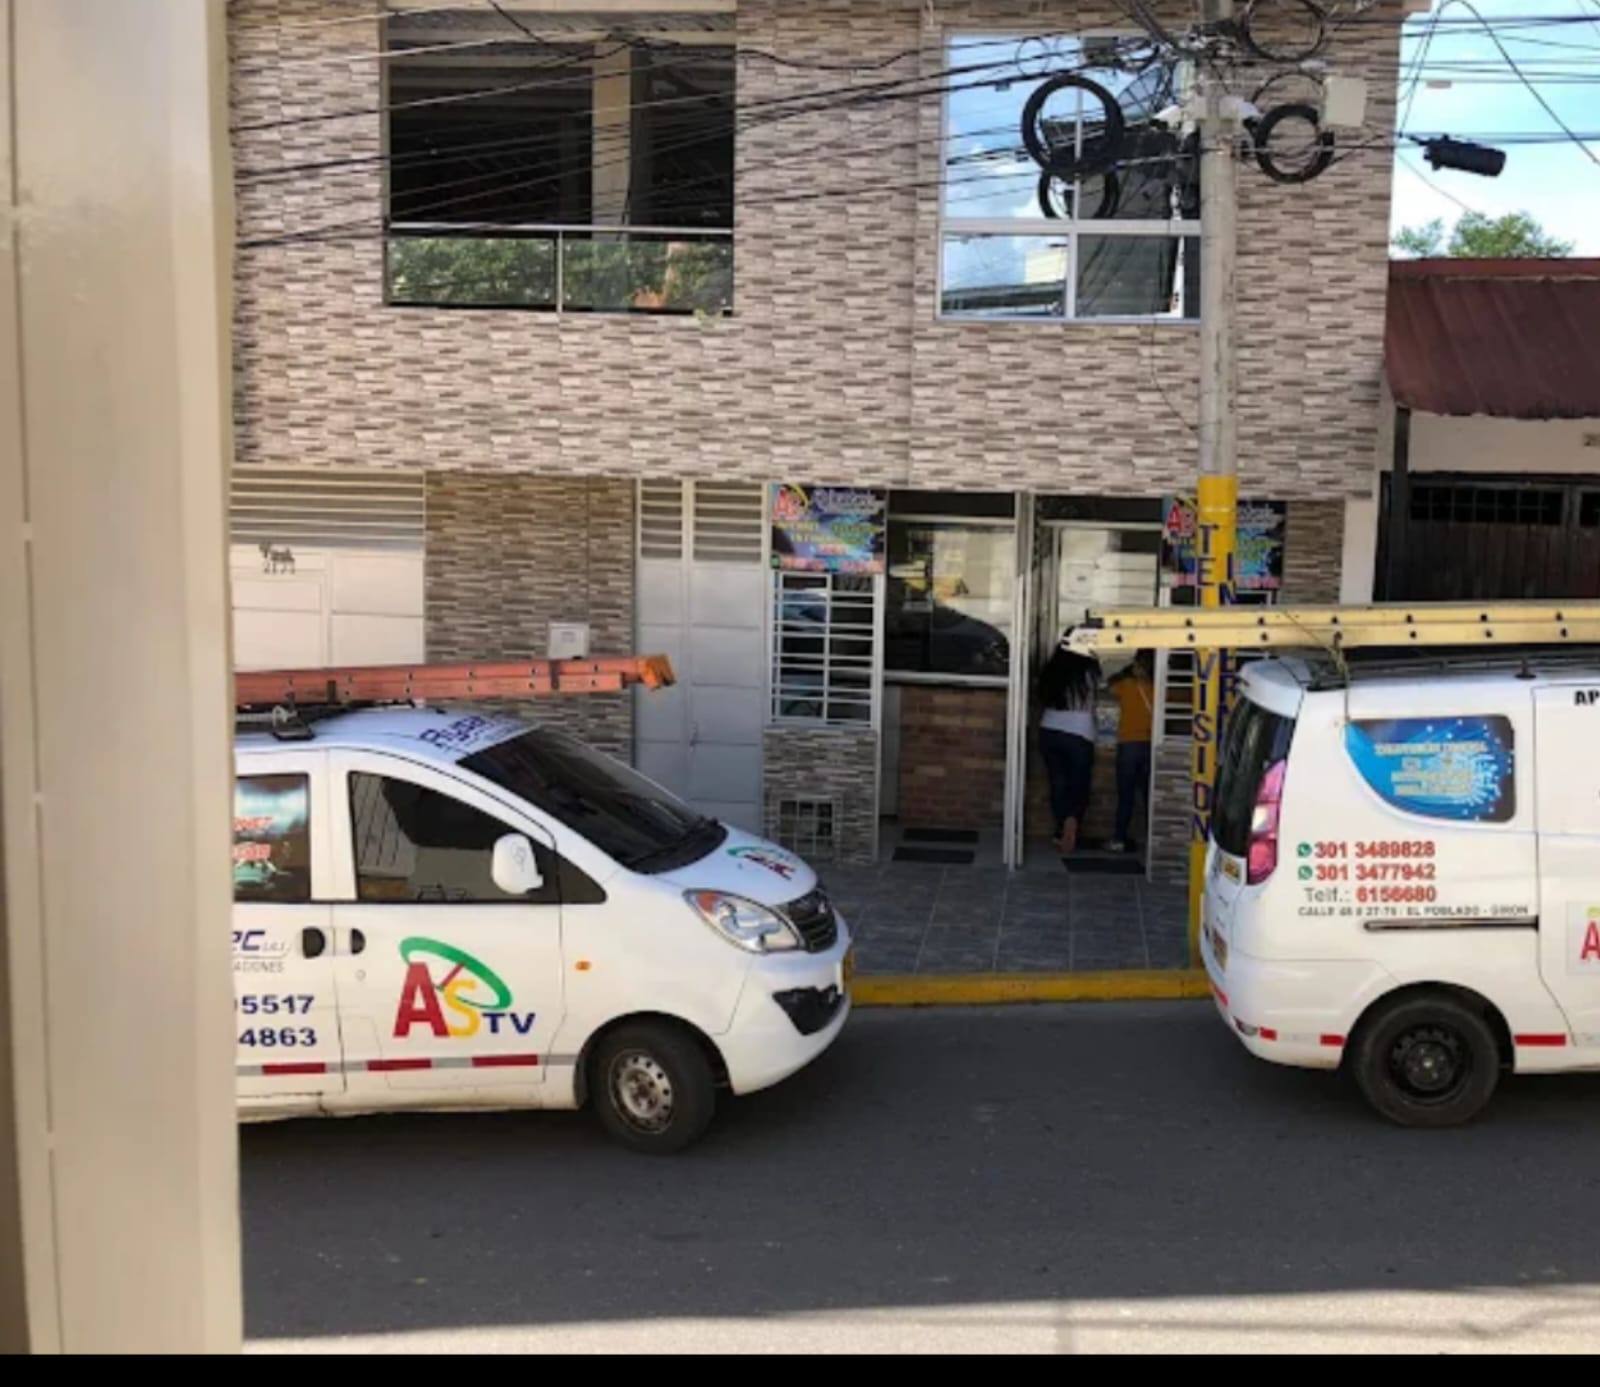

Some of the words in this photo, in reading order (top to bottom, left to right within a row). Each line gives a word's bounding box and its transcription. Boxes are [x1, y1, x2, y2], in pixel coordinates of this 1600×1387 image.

[1314, 841, 1348, 858] 301
[1315, 864, 1349, 881] 301
[234, 994, 315, 1015] 5517
